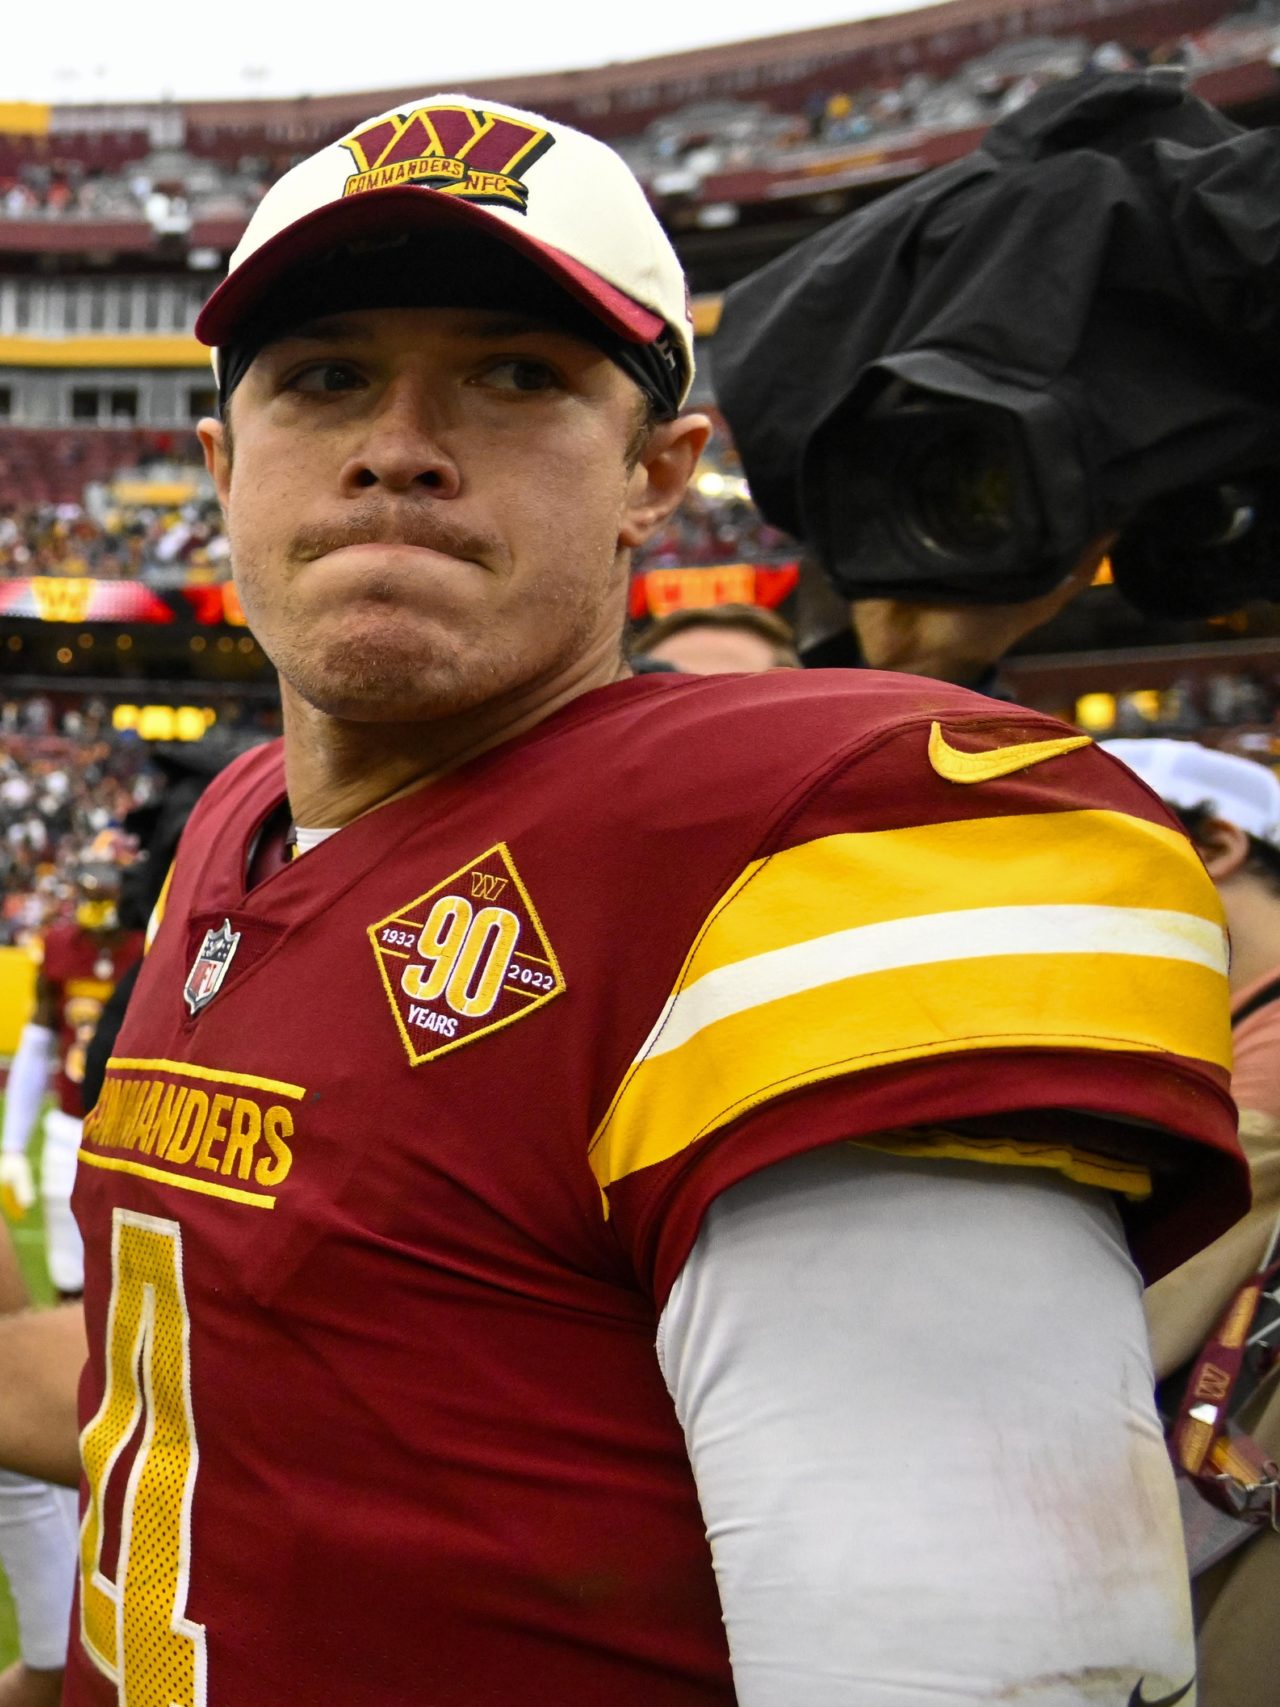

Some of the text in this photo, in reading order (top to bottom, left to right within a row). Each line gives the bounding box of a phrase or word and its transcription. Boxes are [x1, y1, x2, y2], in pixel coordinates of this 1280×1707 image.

[347, 157, 508, 196] COMMANDERS NFC
[381, 928, 416, 948] 1932
[401, 895, 520, 1018] 90
[508, 964, 554, 990] 2022
[406, 1003, 459, 1037] YEARS
[79, 1207, 207, 1707] 4
